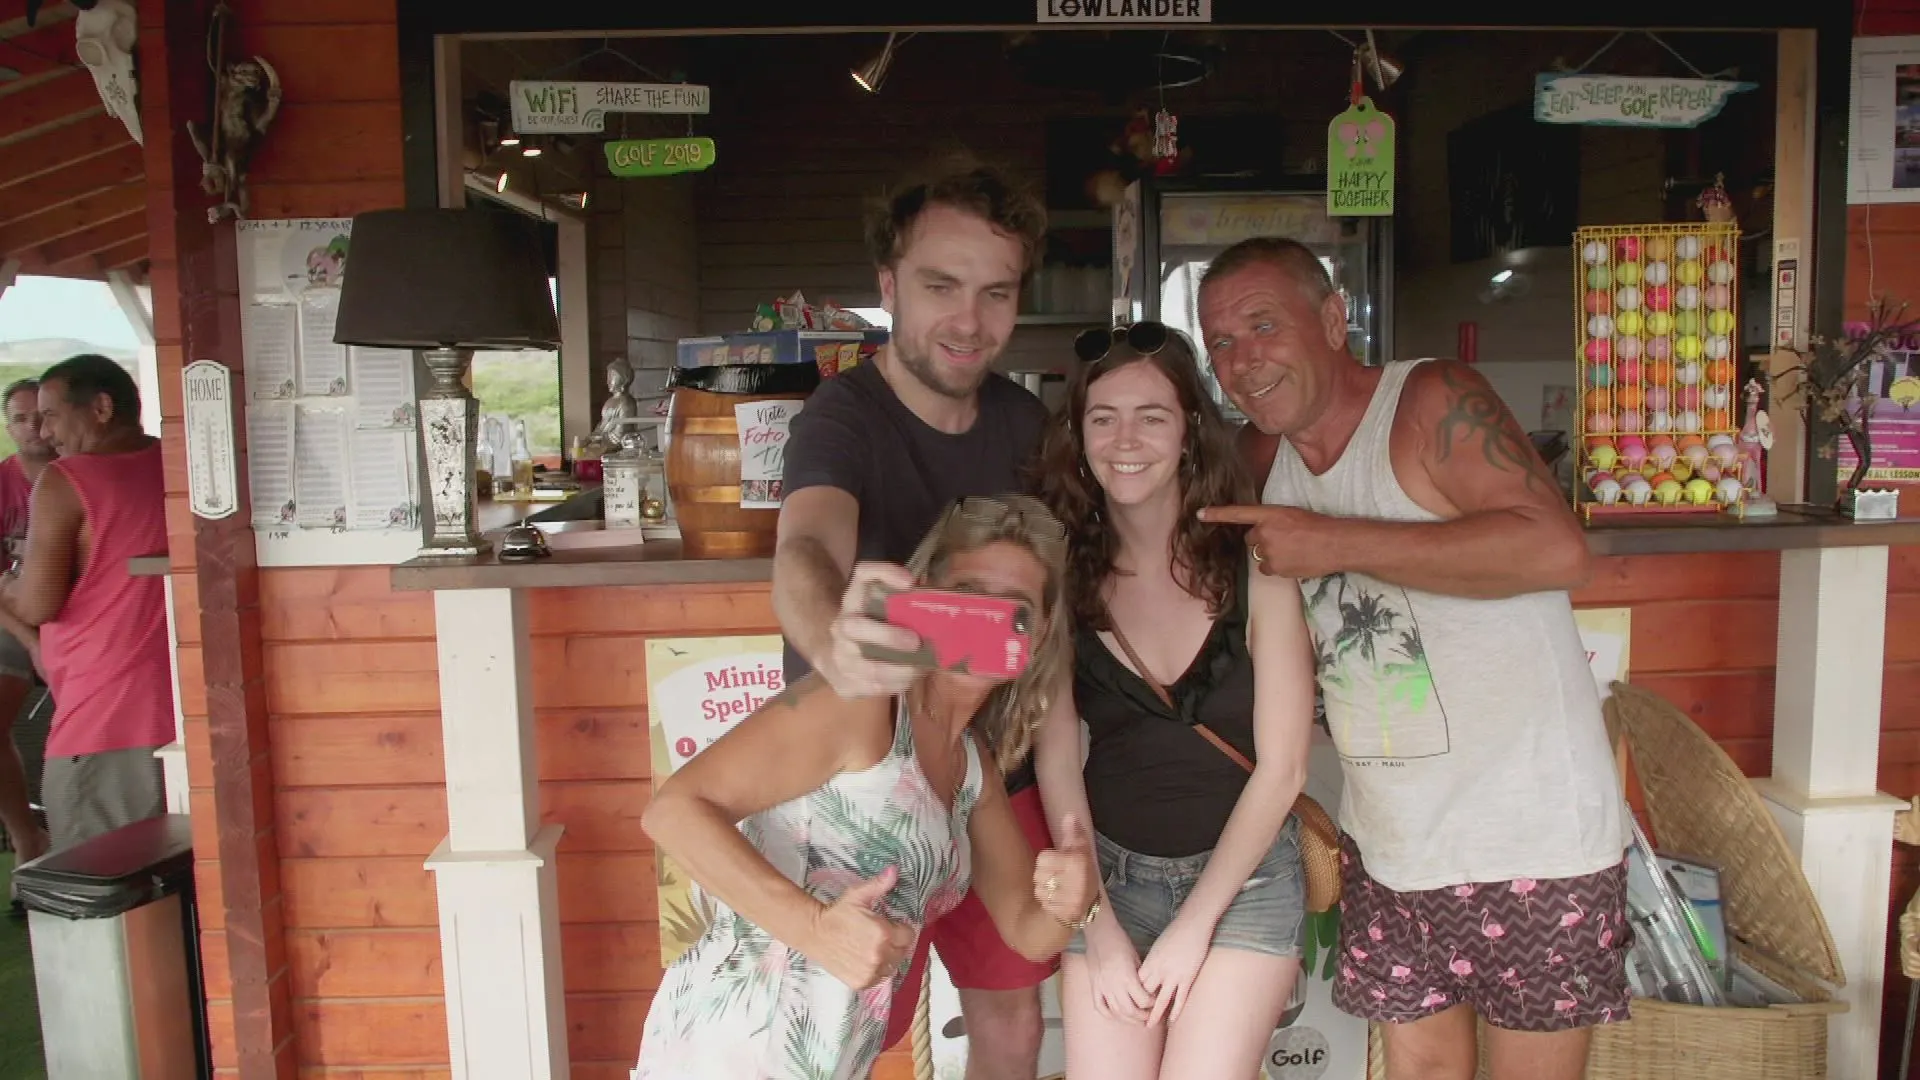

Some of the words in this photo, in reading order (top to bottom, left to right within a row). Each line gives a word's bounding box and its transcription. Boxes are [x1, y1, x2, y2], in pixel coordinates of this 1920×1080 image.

[1047, 0, 1200, 17] LOWLANDER
[524, 87, 579, 114] WiFi
[596, 87, 642, 106] SHARE
[643, 89, 671, 108] THE
[1660, 85, 1719, 111] REPEAT
[614, 143, 657, 167] GOLF
[664, 143, 701, 166] 2019
[1338, 171, 1387, 189] HAPPY
[1330, 189, 1391, 208] TOGETHER
[189, 378, 223, 401] HOME
[744, 426, 785, 446] Foto
[701, 692, 773, 722] Spelr
[1271, 1048, 1325, 1067] Golf
